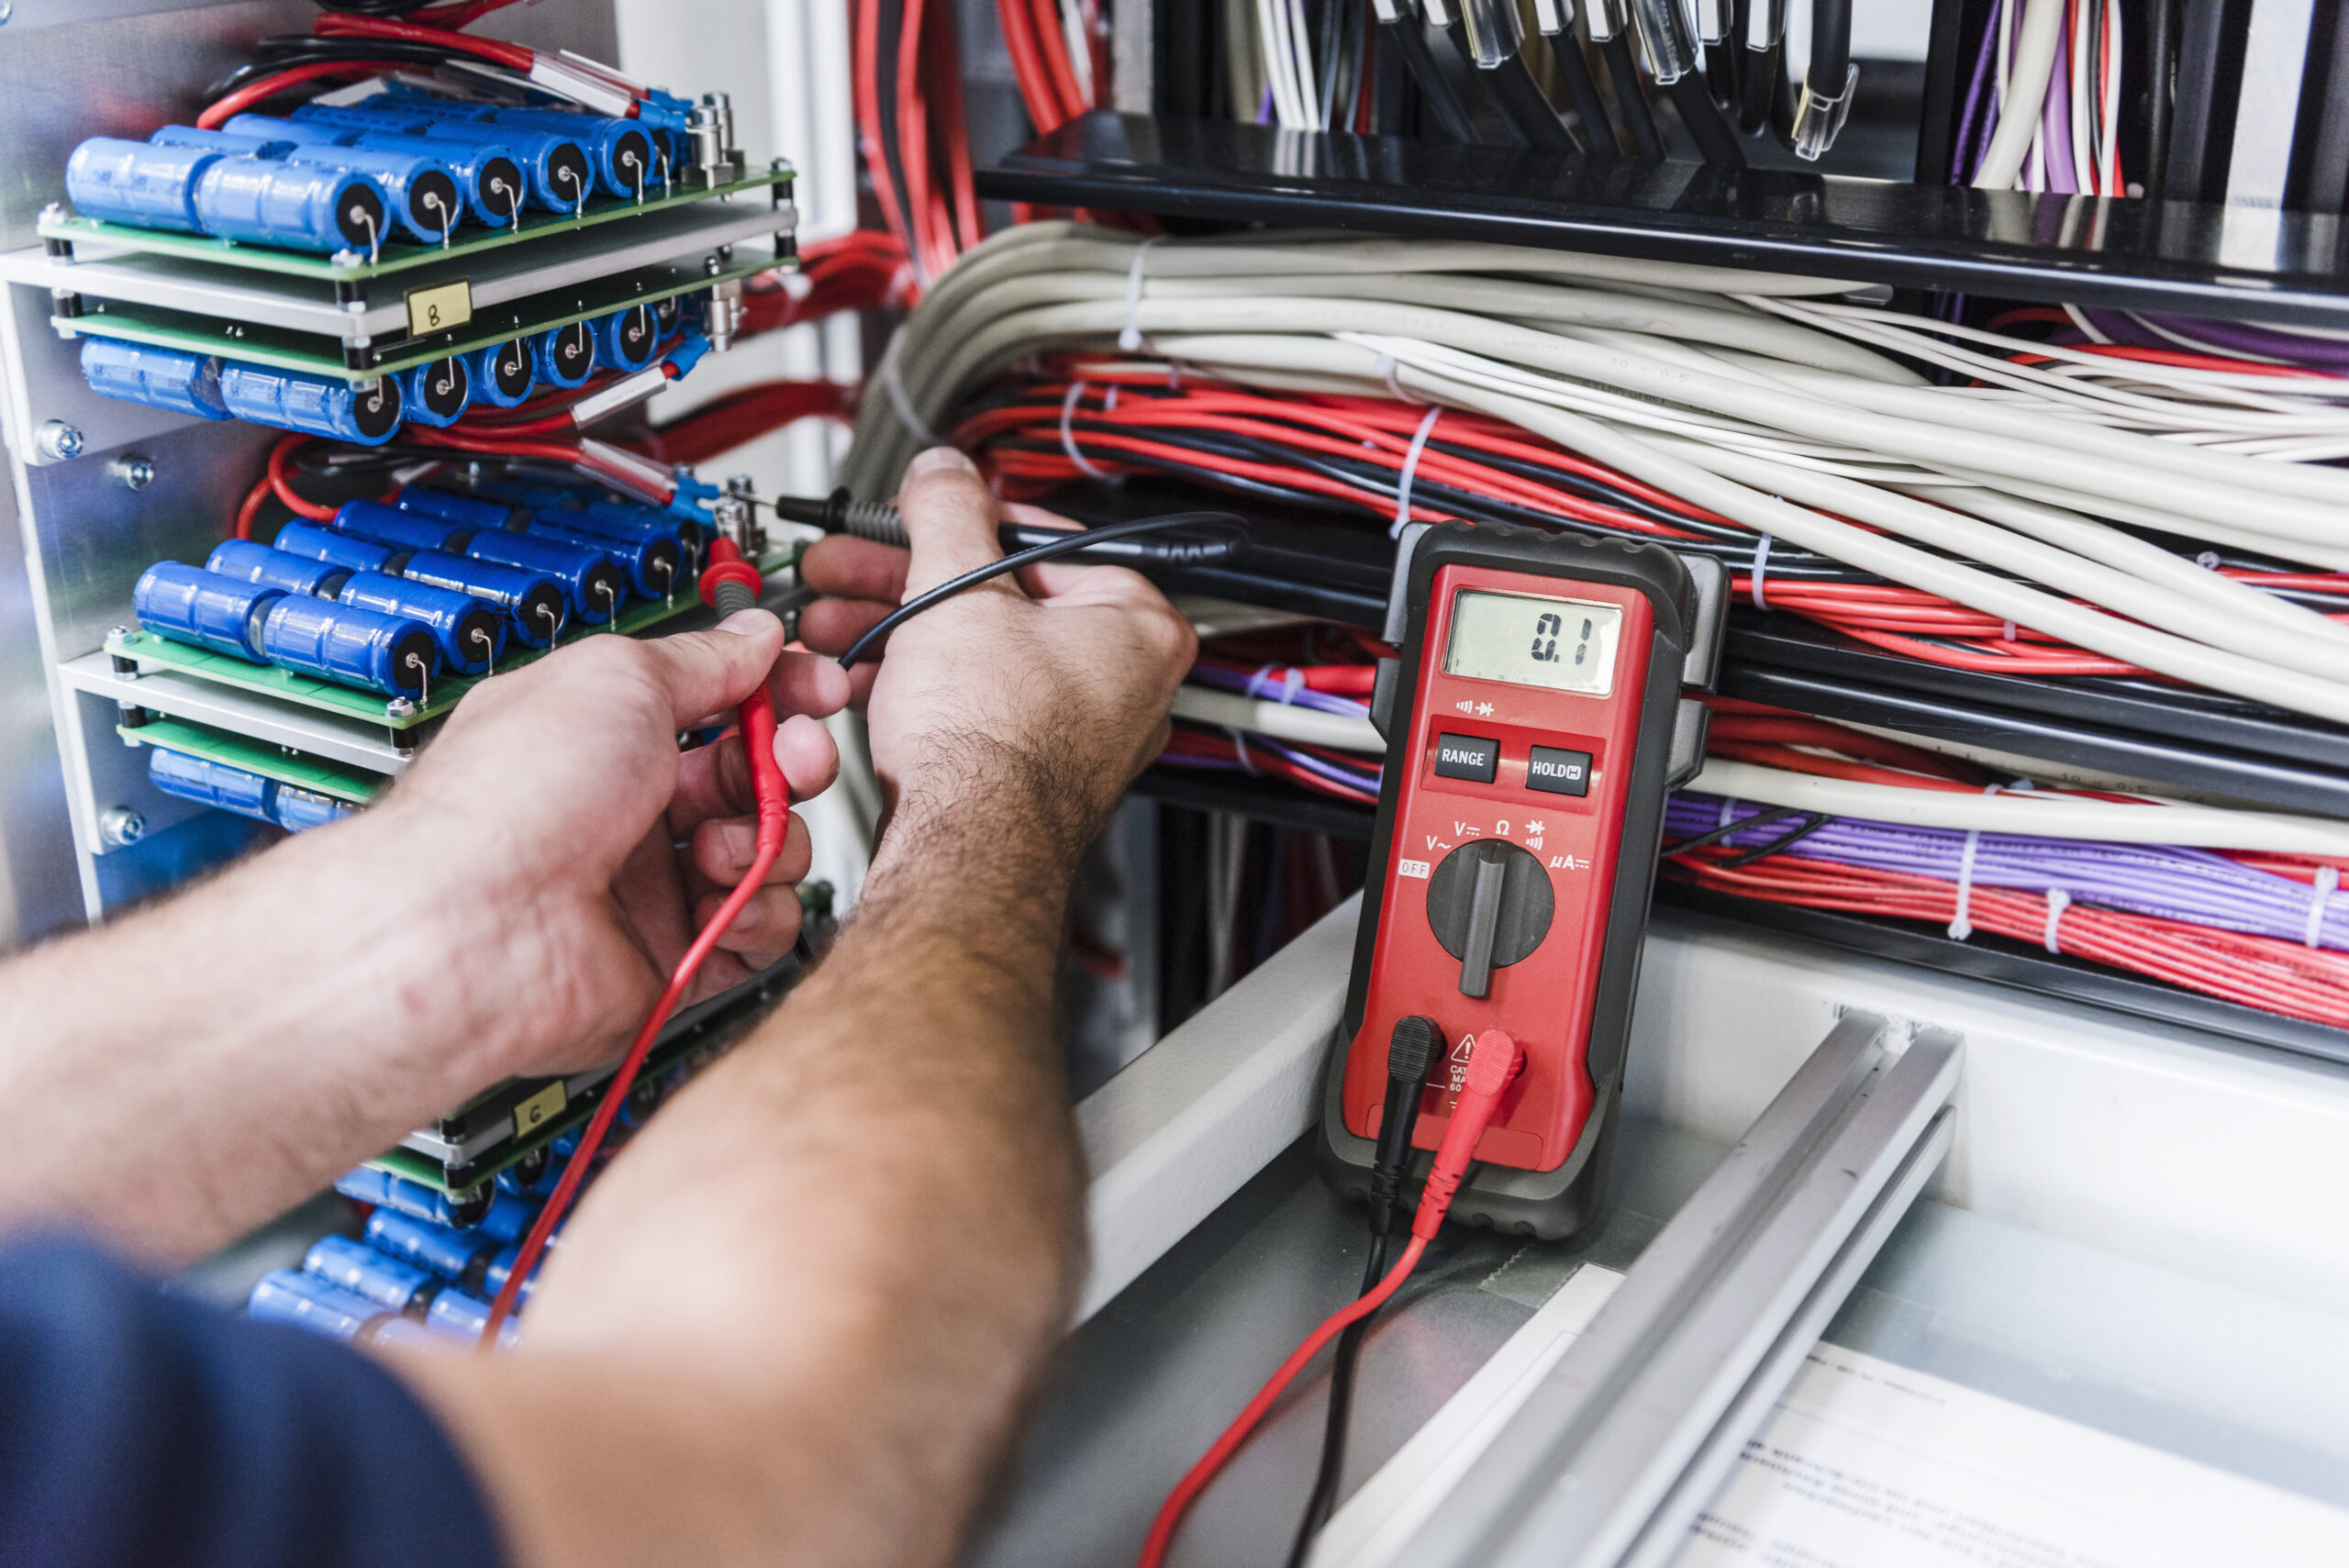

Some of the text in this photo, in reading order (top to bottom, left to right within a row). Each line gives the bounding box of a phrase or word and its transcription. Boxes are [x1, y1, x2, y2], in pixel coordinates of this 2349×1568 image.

[428, 304, 440, 328] 8
[1611, 357, 1629, 369] 10
[1531, 613, 1593, 665] 0.1
[1442, 748, 1486, 767] RANGE
[1531, 761, 1567, 778] HOLD
[1495, 819, 1510, 836] Ω
[1401, 862, 1428, 875] OFF
[1452, 1073, 1466, 1084] MA
[1450, 1083, 1462, 1092] 60
